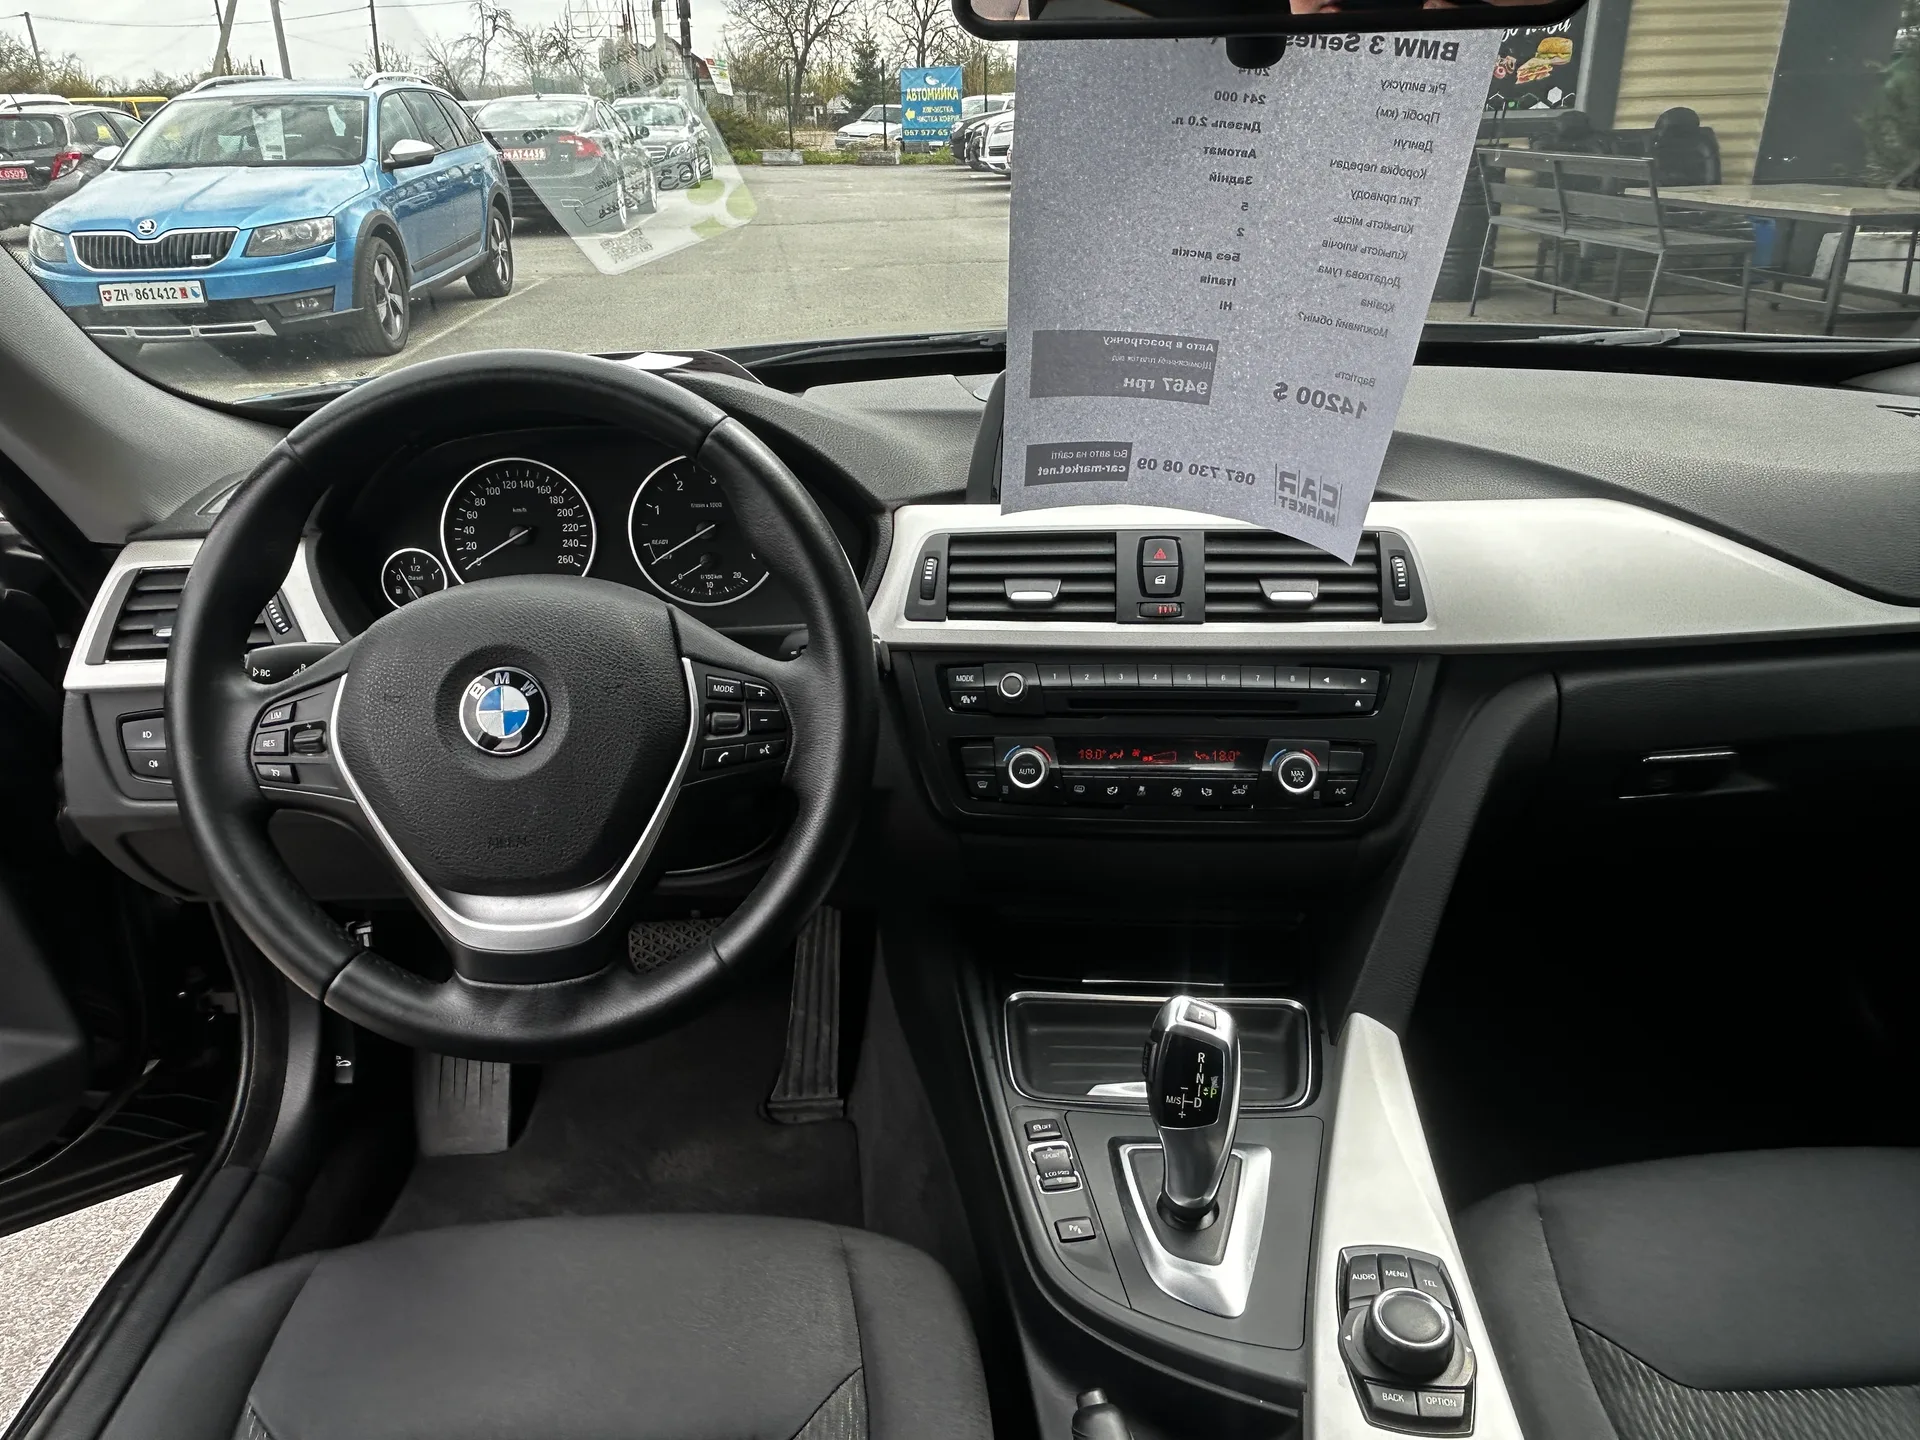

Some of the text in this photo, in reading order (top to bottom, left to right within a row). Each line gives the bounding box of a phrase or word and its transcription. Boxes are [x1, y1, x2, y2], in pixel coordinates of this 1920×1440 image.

[906, 83, 959, 101] АВТОМИЙКА
[114, 289, 130, 302] ZH
[134, 287, 179, 301] 861412
[502, 480, 517, 489] 120
[519, 480, 534, 489] 140
[676, 481, 684, 491] 2
[485, 486, 500, 495] 100
[536, 485, 551, 495] 160
[474, 497, 486, 506] 80
[549, 495, 564, 504] 180
[466, 510, 478, 519] 60
[557, 508, 574, 517] 200
[654, 505, 660, 515] 1
[463, 525, 475, 535] 40
[562, 523, 579, 532] 220
[465, 541, 477, 550] 20
[562, 539, 579, 548] 240
[557, 555, 574, 564] 260
[431, 573, 435, 581] 1
[732, 571, 742, 579] 20
[706, 581, 714, 589] 10
[955, 674, 974, 682] MODE
[1084, 673, 1090, 681] 2
[1152, 673, 1158, 681] 4
[1255, 674, 1260, 682] 7
[468, 671, 538, 700] BMW
[712, 684, 735, 694] MODE
[270, 711, 282, 720] LIM
[262, 740, 276, 748] RES
[1335, 787, 1347, 795] A/C
[1198, 1011, 1206, 1020] P
[1197, 1052, 1206, 1063] R
[1195, 1073, 1204, 1084] N
[1210, 1087, 1217, 1098] P
[1165, 1095, 1181, 1105] M/S
[1193, 1097, 1202, 1108] D
[1385, 1270, 1408, 1279] MENU
[1423, 1279, 1438, 1288] TEL
[1382, 1392, 1405, 1402] BACK
[1425, 1396, 1457, 1407] OPTION
